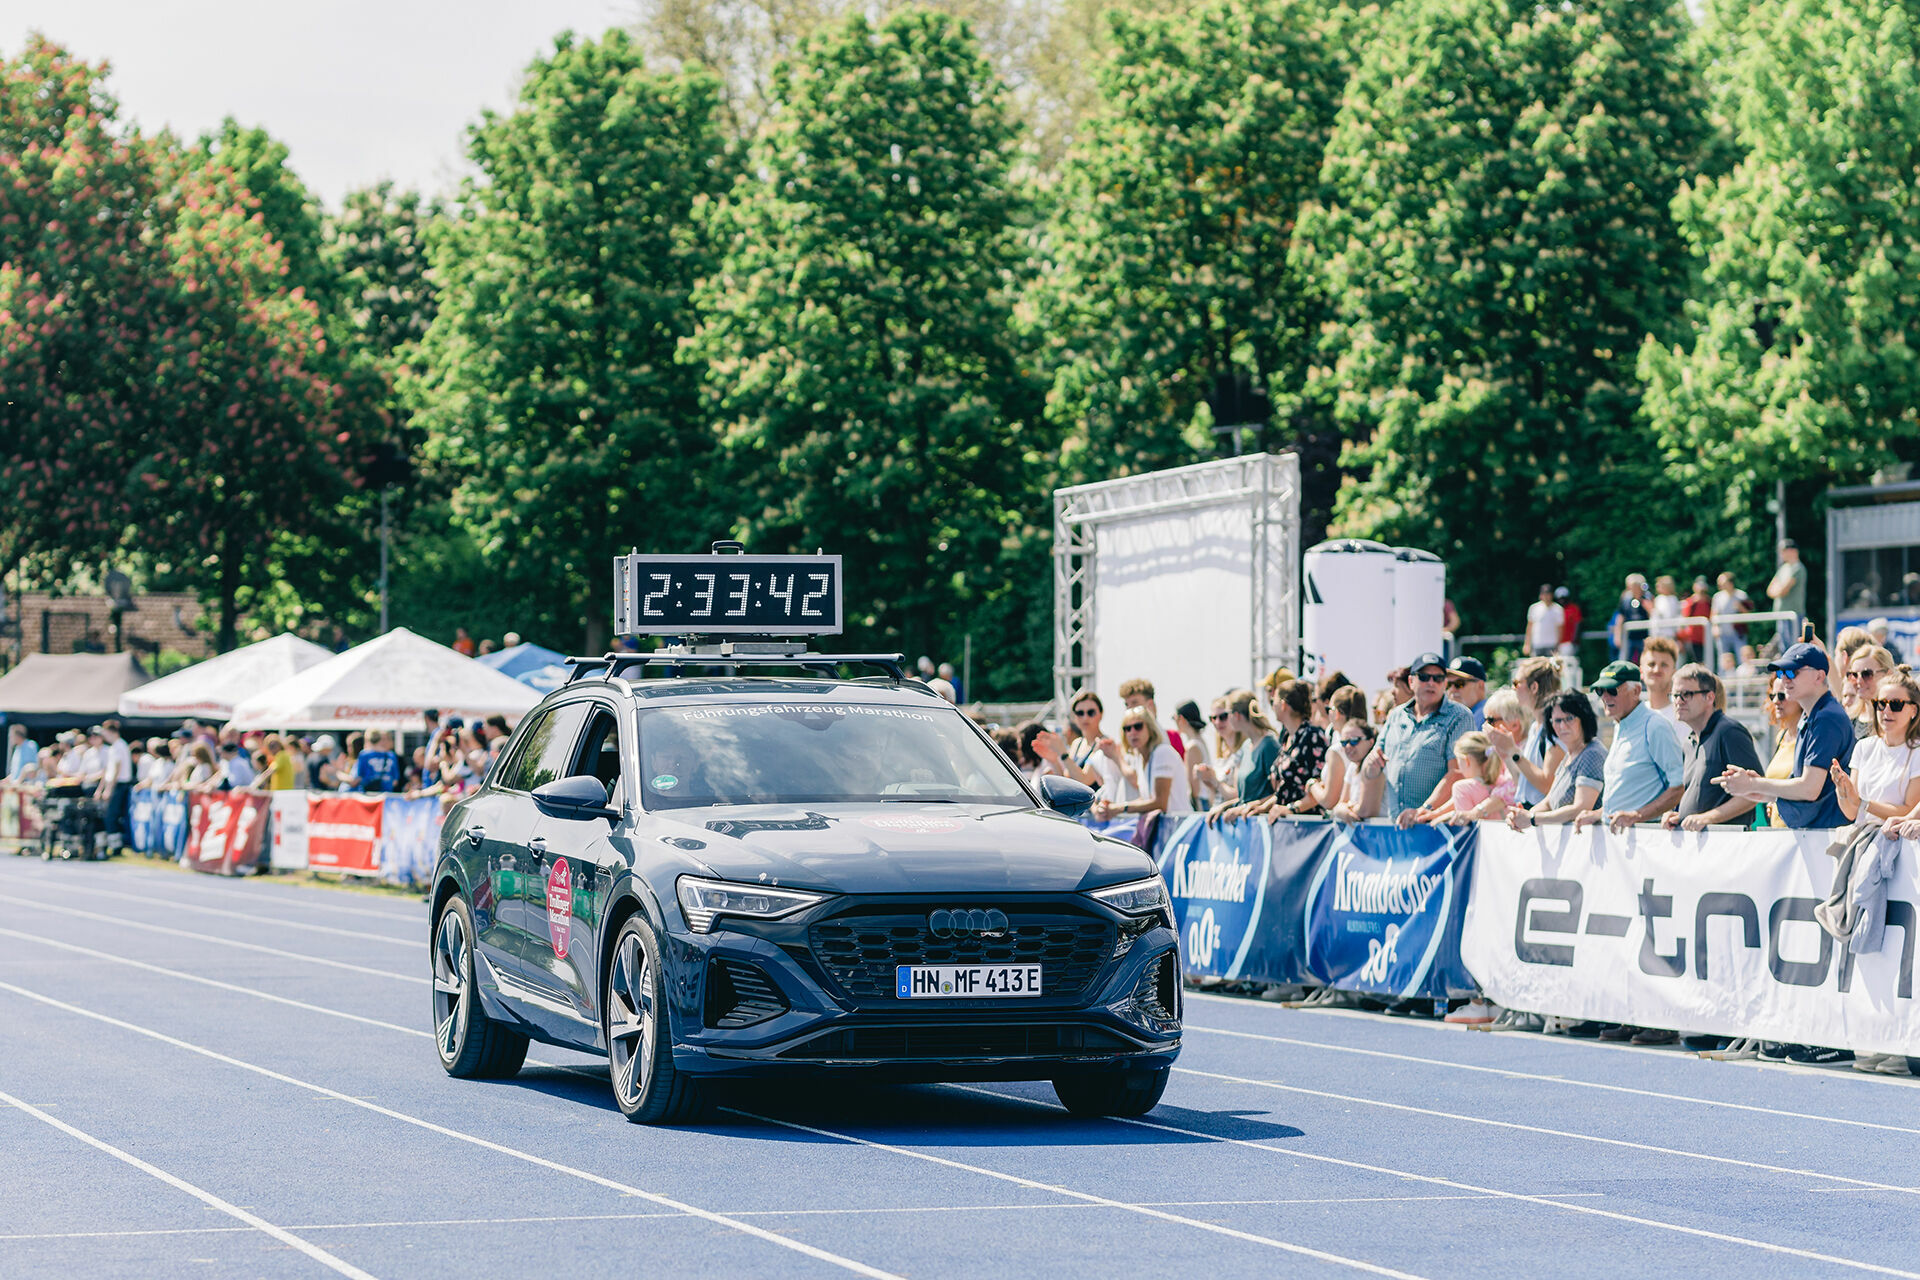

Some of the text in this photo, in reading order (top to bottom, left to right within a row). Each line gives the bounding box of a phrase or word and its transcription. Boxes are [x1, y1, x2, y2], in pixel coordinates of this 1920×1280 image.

[643, 573, 829, 616] 2:33:42
[681, 704, 935, 722] Führungsfahrzeug Marathon
[1515, 878, 1917, 999] e-tron
[913, 970, 940, 994] HN
[954, 969, 981, 993] MF
